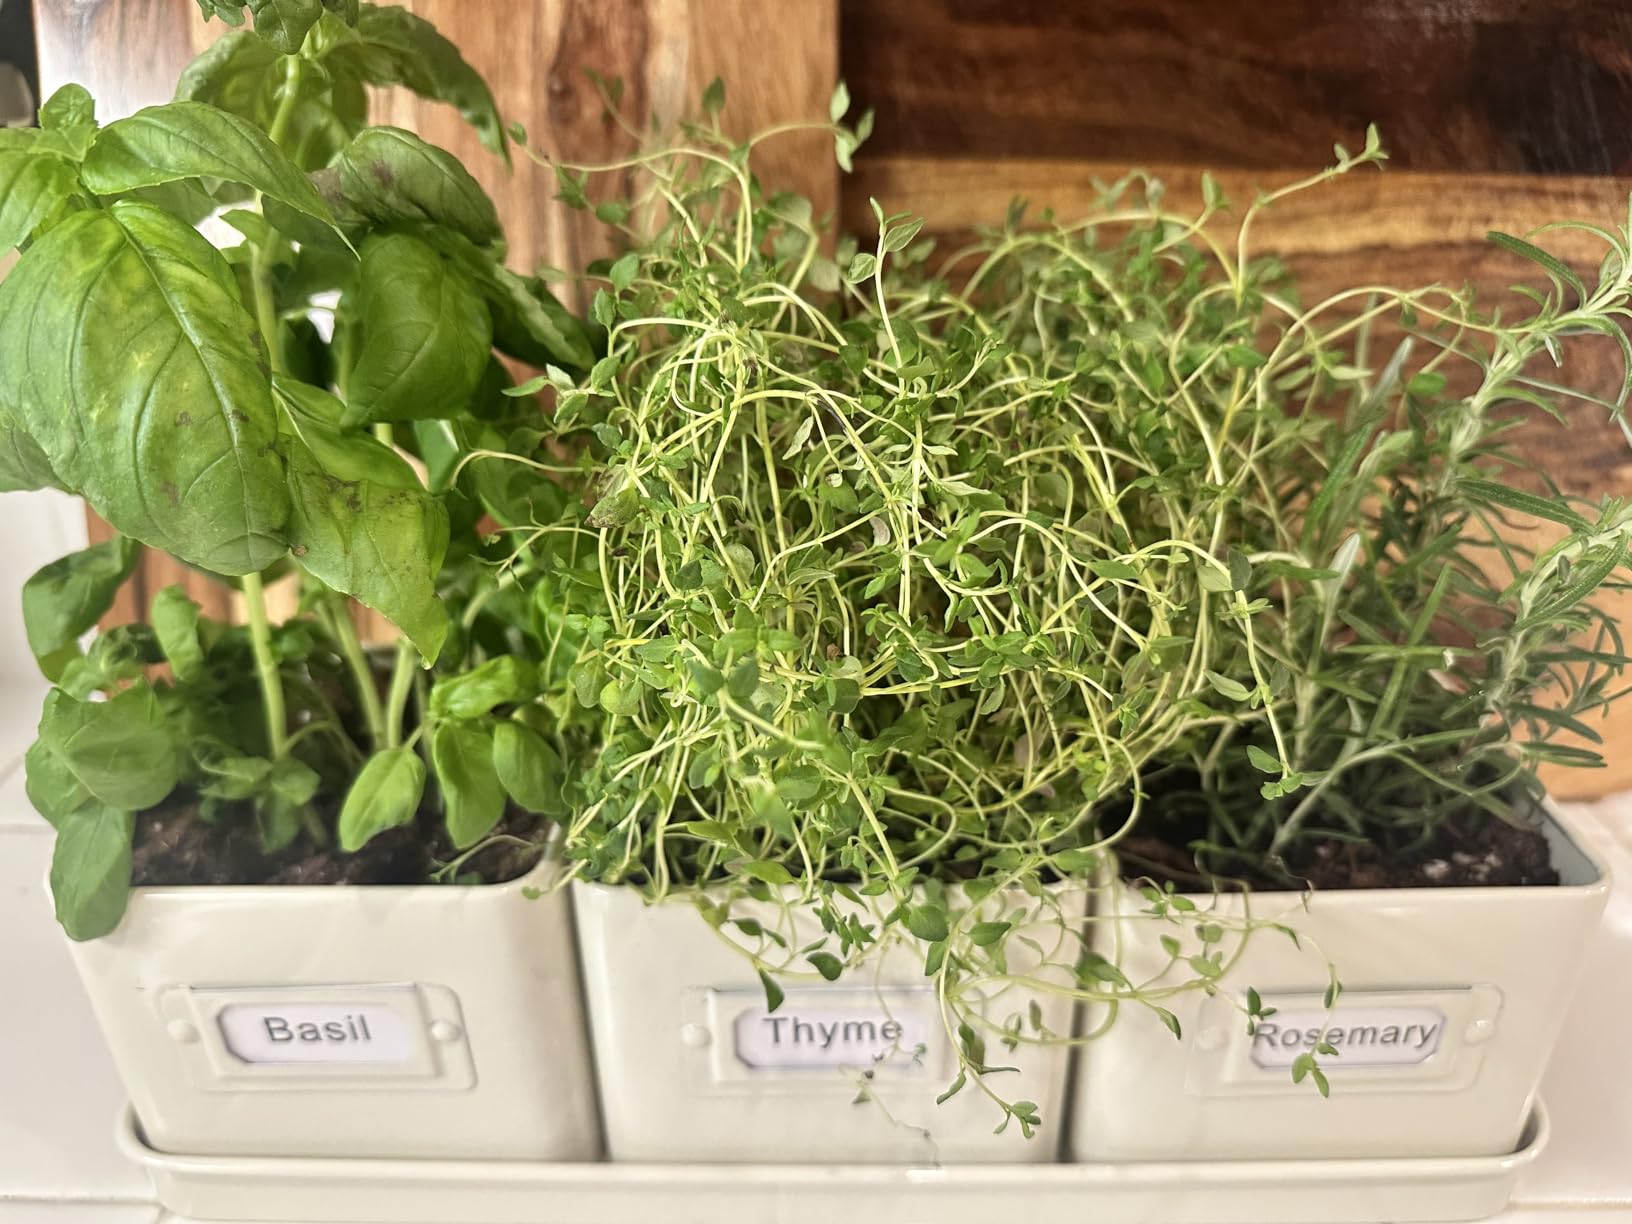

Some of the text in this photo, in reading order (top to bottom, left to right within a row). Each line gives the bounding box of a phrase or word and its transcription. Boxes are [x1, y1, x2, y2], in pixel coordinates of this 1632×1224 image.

[263, 1014, 371, 1042] Basil
[762, 1016, 902, 1048] Thyme
[1253, 1022, 1438, 1049] Rosemary
